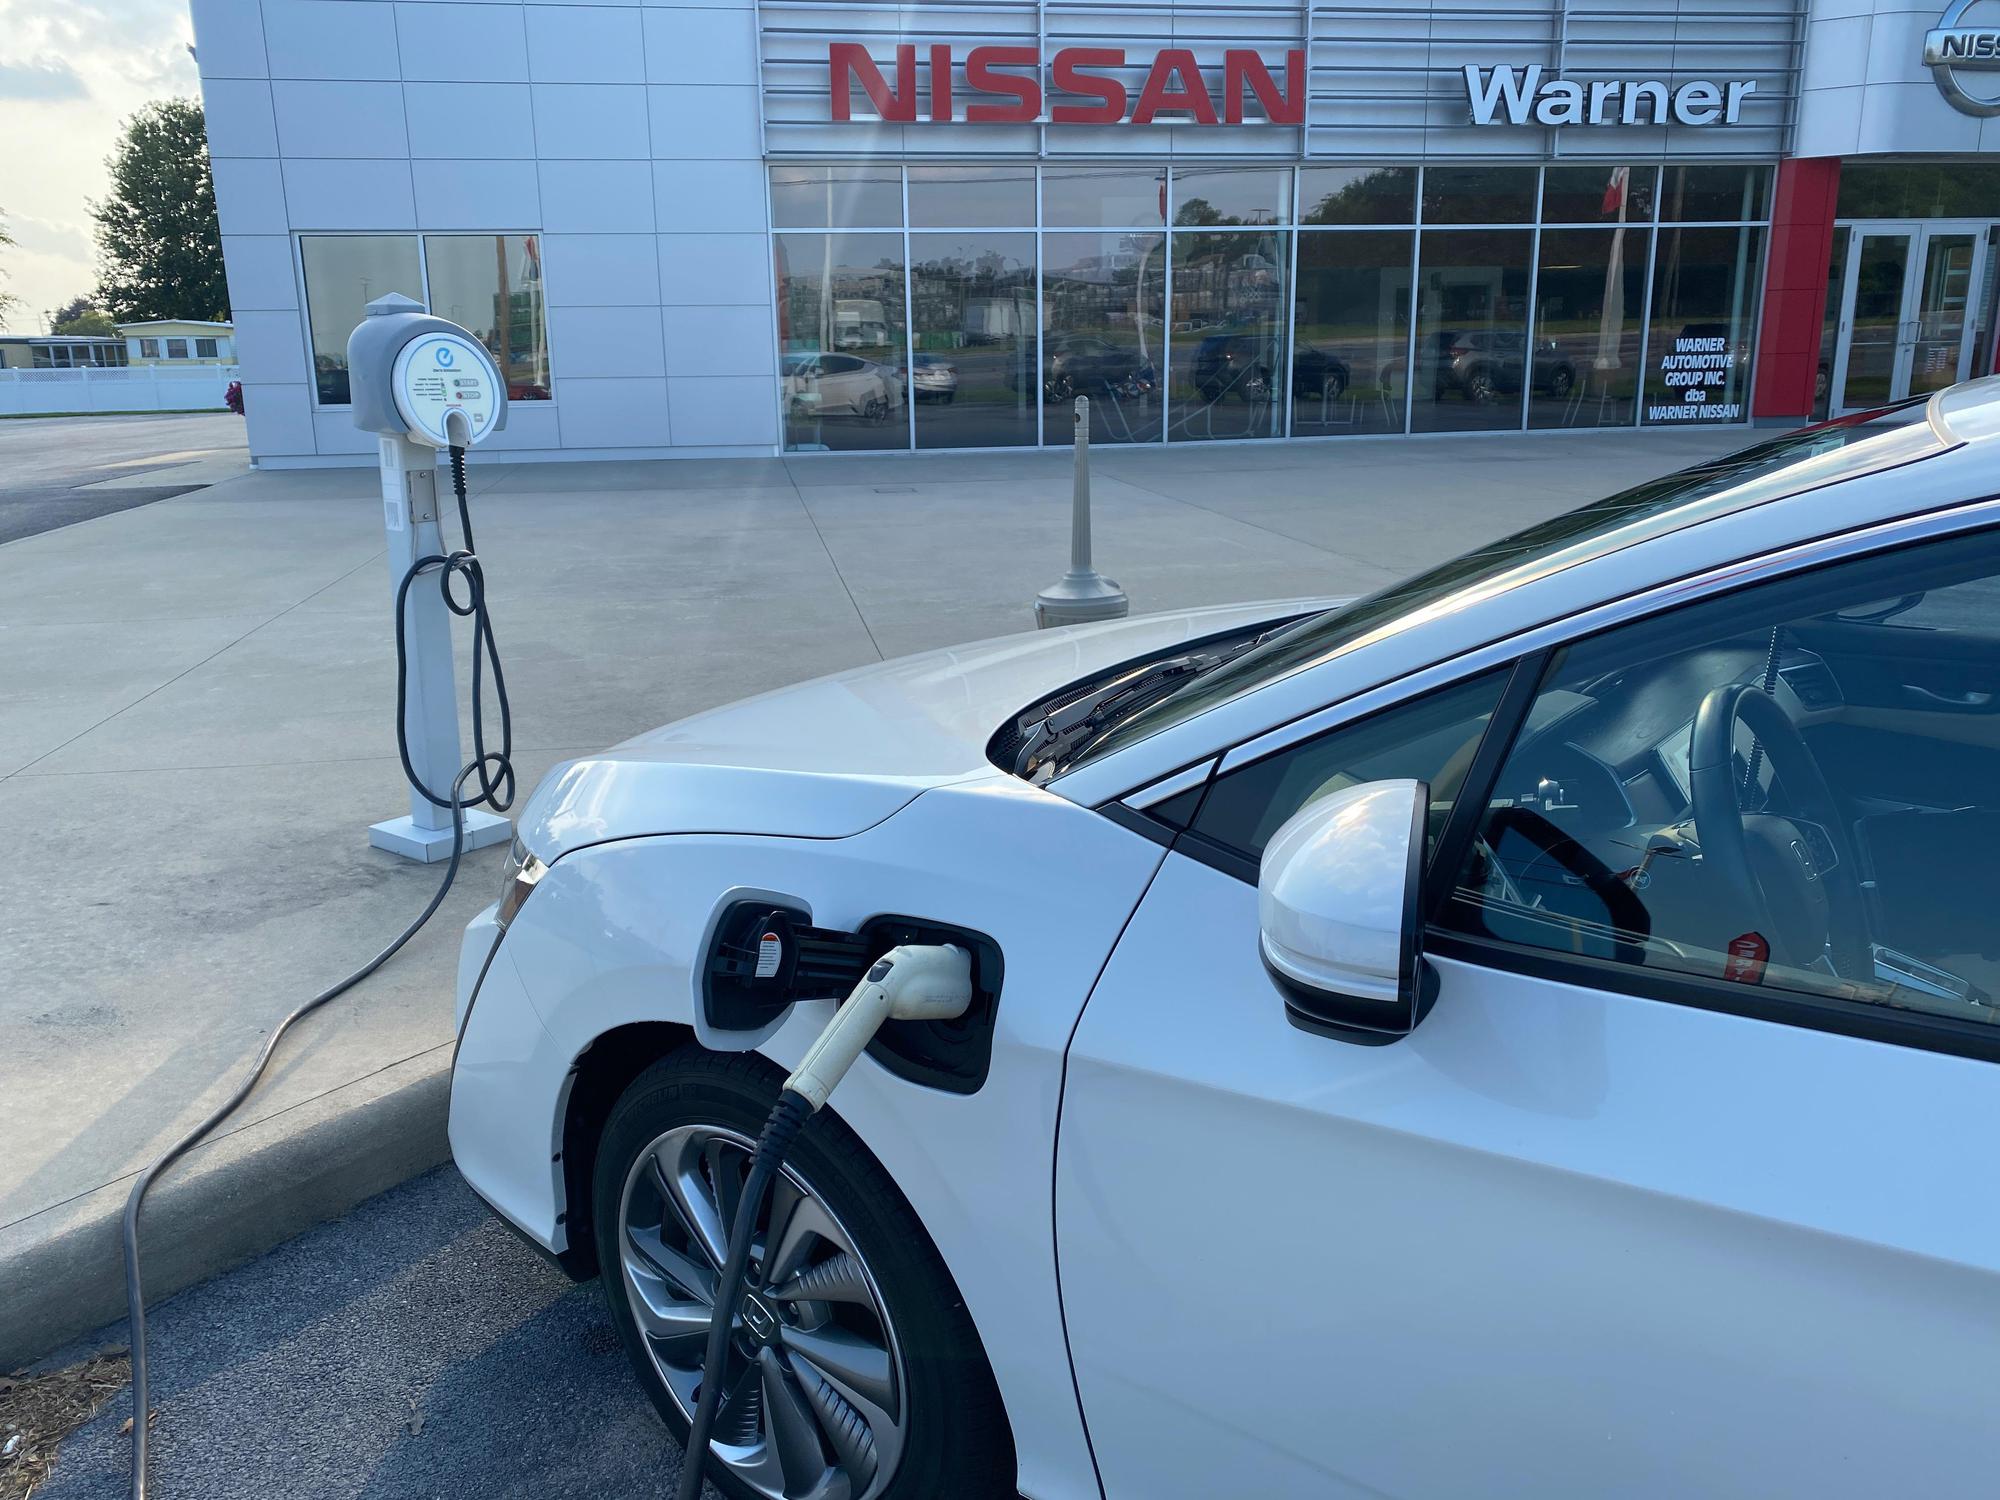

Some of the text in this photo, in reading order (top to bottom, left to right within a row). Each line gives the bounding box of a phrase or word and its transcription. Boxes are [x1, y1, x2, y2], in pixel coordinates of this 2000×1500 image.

[1942, 33, 2000, 58] NIS
[829, 43, 1305, 123] NISSAN
[1462, 64, 1756, 126] Warner
[1676, 338, 1725, 352] WARNER
[1661, 354, 1734, 369] AUTOMOTIVE
[1665, 371, 1725, 386] GROUP INC.
[1685, 389, 1706, 402] dba
[1649, 404, 1740, 420] WARNER NISSAN
